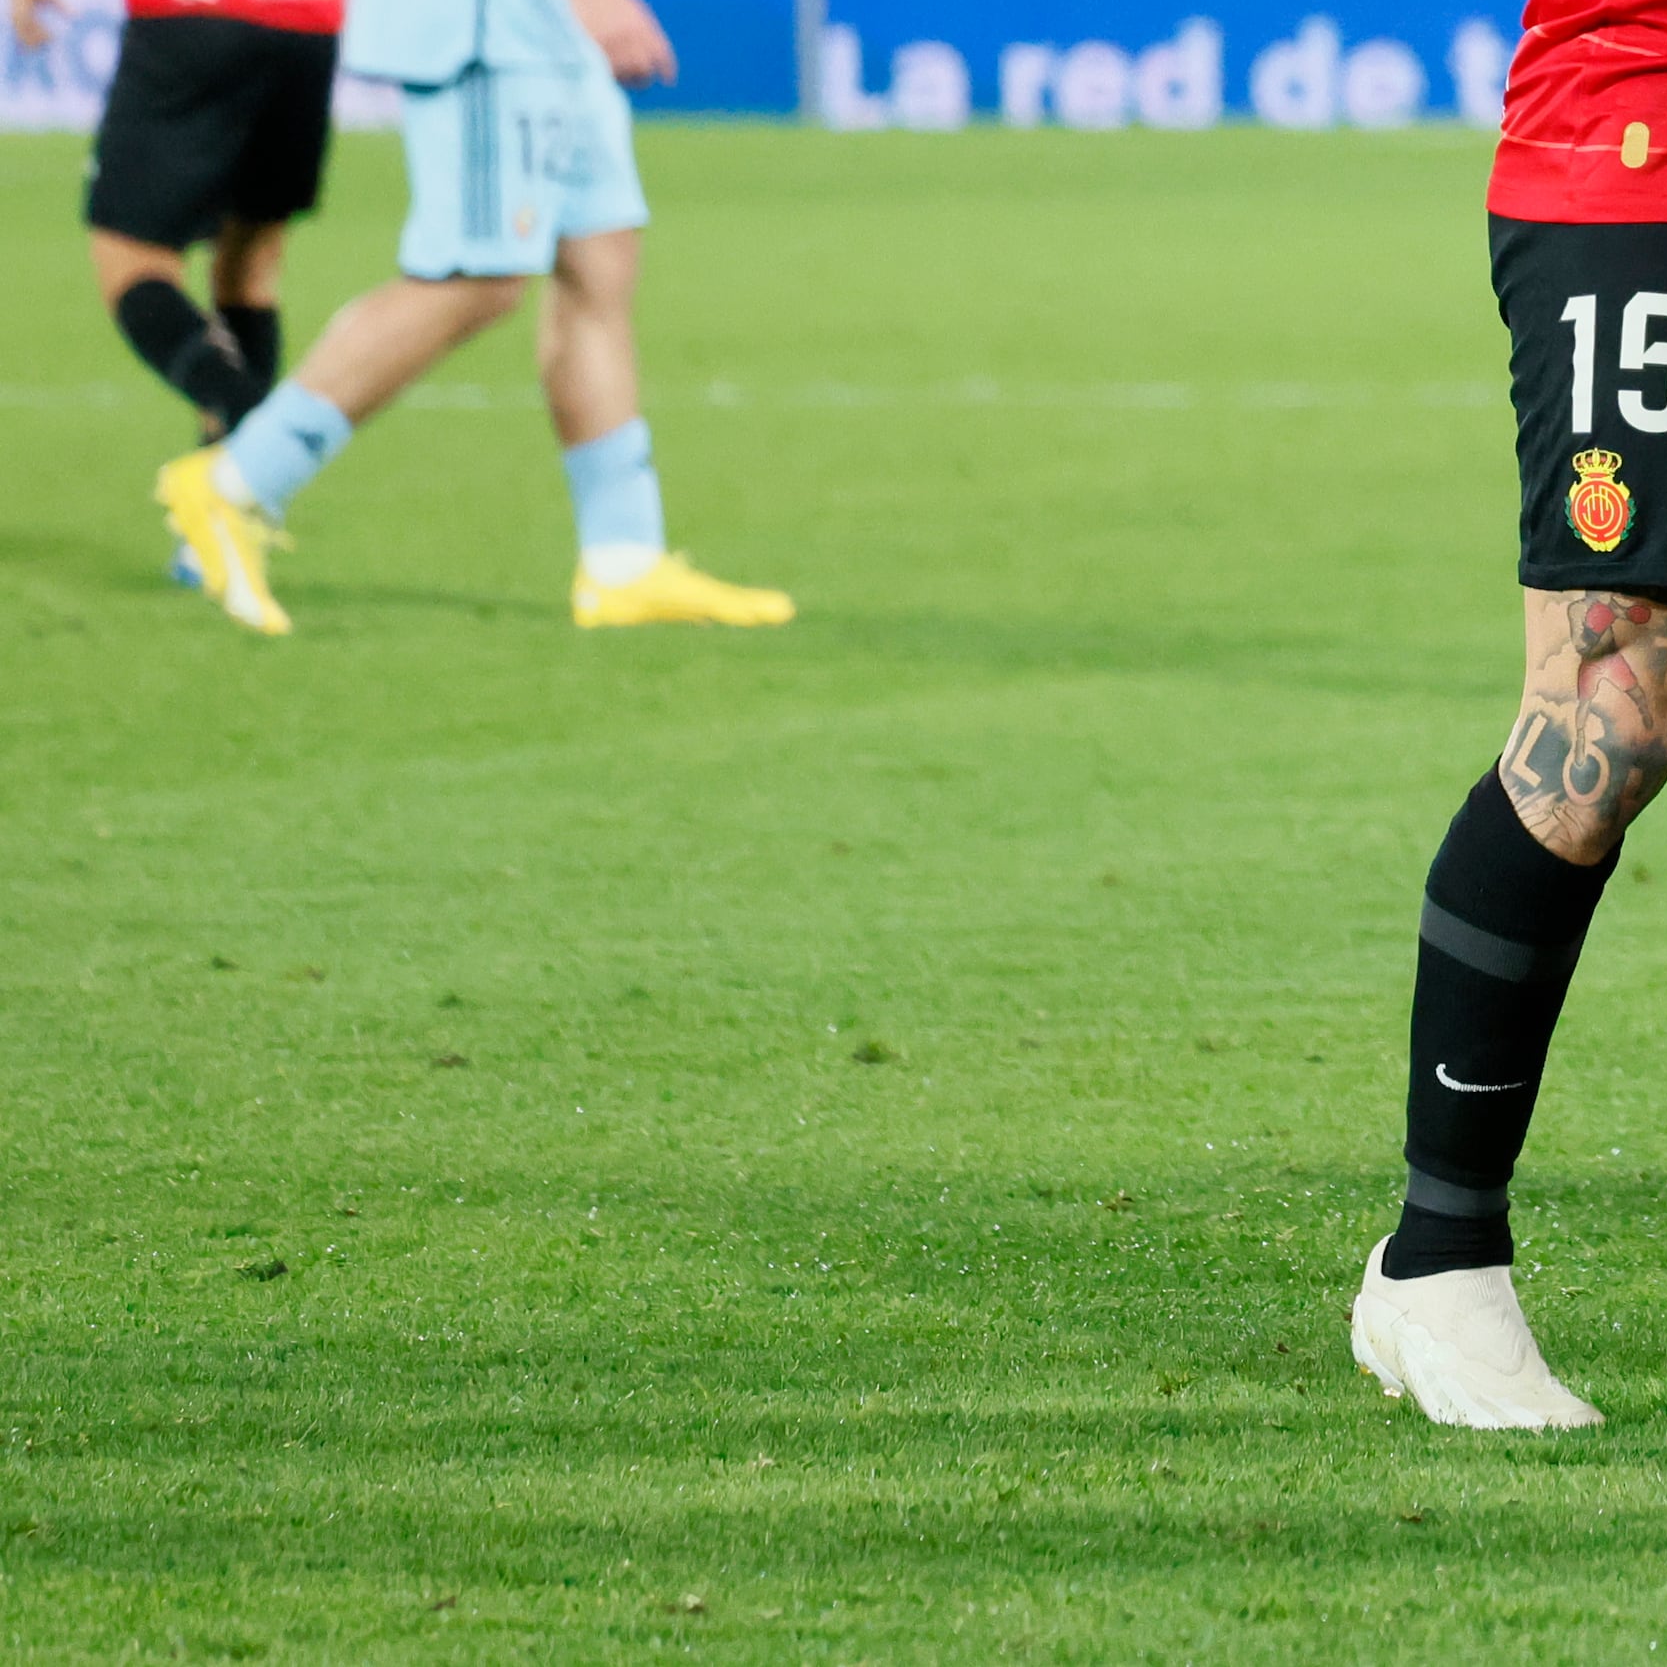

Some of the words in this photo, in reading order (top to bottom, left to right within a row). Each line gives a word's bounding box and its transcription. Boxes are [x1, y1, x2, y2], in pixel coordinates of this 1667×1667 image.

[820, 23, 972, 130] La
[1003, 15, 1223, 129] red
[1248, 15, 1428, 129] de
